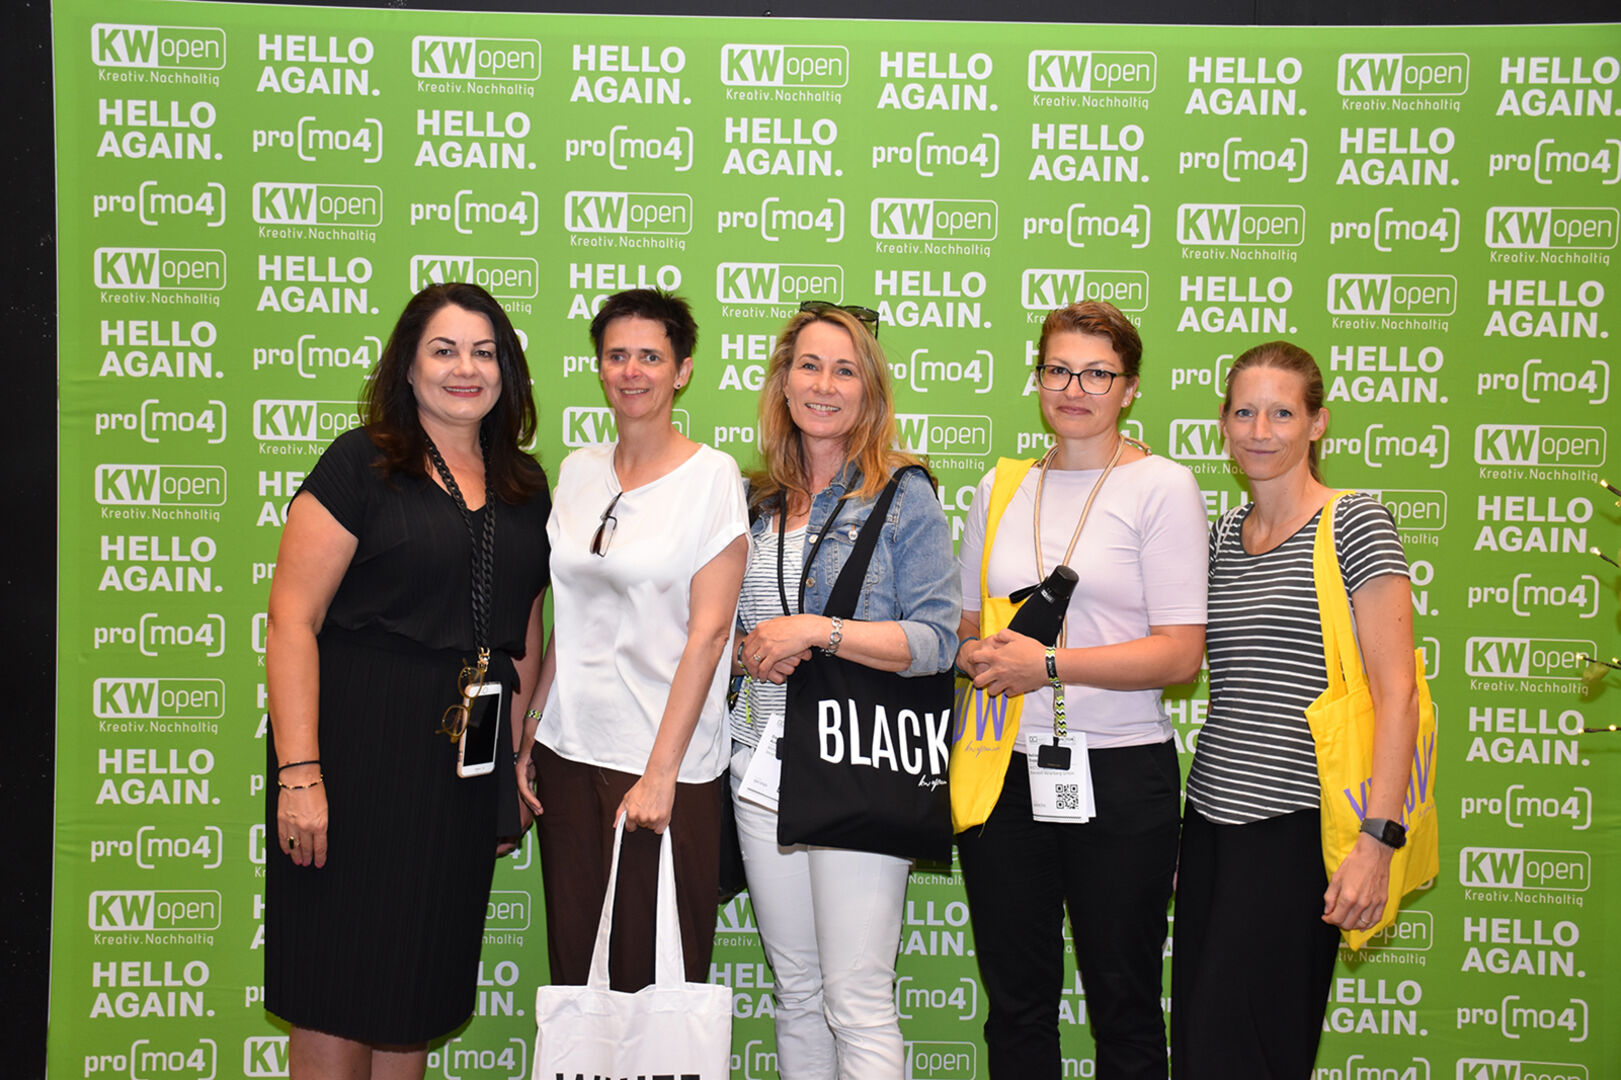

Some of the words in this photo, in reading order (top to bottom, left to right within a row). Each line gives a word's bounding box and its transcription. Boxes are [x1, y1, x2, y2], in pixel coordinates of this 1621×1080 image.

[98, 28, 155, 63] KW
[160, 37, 220, 65] open
[259, 33, 374, 64] HELLO
[419, 40, 473, 74] KW
[477, 49, 536, 76] open
[572, 44, 686, 74] HELLO
[727, 49, 780, 82] KW
[786, 56, 843, 83] open
[880, 51, 993, 80] HELLO
[1035, 55, 1088, 88] KW
[1093, 63, 1151, 89] open
[1188, 56, 1302, 84] HELLO
[1344, 58, 1400, 91] KW
[1404, 64, 1463, 91] open
[1501, 56, 1620, 84] HELLO
[256, 66, 380, 96] AGAIN.
[570, 76, 692, 104] AGAIN.
[877, 83, 998, 111] AGAIN.
[1184, 88, 1307, 116] AGAIN.
[1496, 89, 1621, 116] AGAIN.
[99, 98, 216, 128] HELLO
[417, 109, 531, 138] HELLO
[97, 131, 223, 160] AGAIN.
[725, 117, 838, 146] HELLO
[1032, 123, 1144, 151] HELLO
[1340, 127, 1455, 154] HELLO
[414, 141, 536, 170] AGAIN.
[722, 148, 843, 176] AGAIN.
[1028, 154, 1149, 183] AGAIN.
[1336, 159, 1459, 186] AGAIN.
[259, 187, 314, 220] KW
[319, 195, 377, 221] open
[571, 196, 625, 228] KW
[629, 204, 687, 229] open
[877, 203, 930, 235] KW
[935, 210, 992, 236] open
[1183, 208, 1237, 241] KW
[1242, 216, 1299, 241] open
[1492, 211, 1549, 244] KW
[1553, 219, 1612, 244] open
[101, 252, 156, 285] KW
[162, 260, 220, 285] open
[259, 255, 373, 284] HELLO
[476, 268, 532, 293] open
[570, 263, 682, 291] HELLO
[723, 267, 776, 299] KW
[781, 275, 838, 301] open
[875, 270, 986, 298] HELLO
[1028, 272, 1083, 308] KW
[1180, 276, 1292, 303] HELLO
[1333, 278, 1388, 311] KW
[1393, 286, 1450, 311] open
[1488, 280, 1604, 307] HELLO
[257, 286, 379, 314] AGAIN.
[873, 300, 992, 328] AGAIN.
[101, 320, 217, 347] HELLO
[1176, 306, 1297, 334] AGAIN.
[1484, 311, 1608, 338] AGAIN.
[100, 351, 224, 378] AGAIN.
[1330, 346, 1443, 372] HELLO
[1327, 376, 1448, 403] AGAIN.
[260, 403, 314, 437] KW
[930, 425, 986, 450] open
[1480, 428, 1537, 461] KW
[1541, 437, 1599, 461] open
[101, 468, 157, 501] KW
[163, 476, 220, 501] open
[1478, 496, 1593, 523] HELLO
[101, 536, 216, 562] HELLO
[99, 566, 222, 592] AGAIN.
[1471, 641, 1527, 674] KW
[1532, 650, 1590, 674] open
[100, 682, 156, 714] KW
[161, 689, 219, 714] open
[1469, 707, 1584, 735] HELLO
[817, 697, 951, 776] BLACK
[99, 749, 214, 774] HELLO
[1466, 737, 1589, 765] AGAIN.
[96, 779, 220, 804] AGAIN.
[1465, 851, 1521, 885] KW
[1526, 861, 1584, 885] open
[95, 894, 152, 927] KW
[157, 901, 215, 926] open
[903, 900, 969, 927] LLO
[1464, 917, 1579, 946] HELLO
[93, 961, 209, 987] HELLO
[1462, 948, 1585, 977] AGAIN.
[90, 992, 214, 1018] AGAIN.
[1328, 978, 1422, 1005] ELLO
[915, 1052, 970, 1077] open
